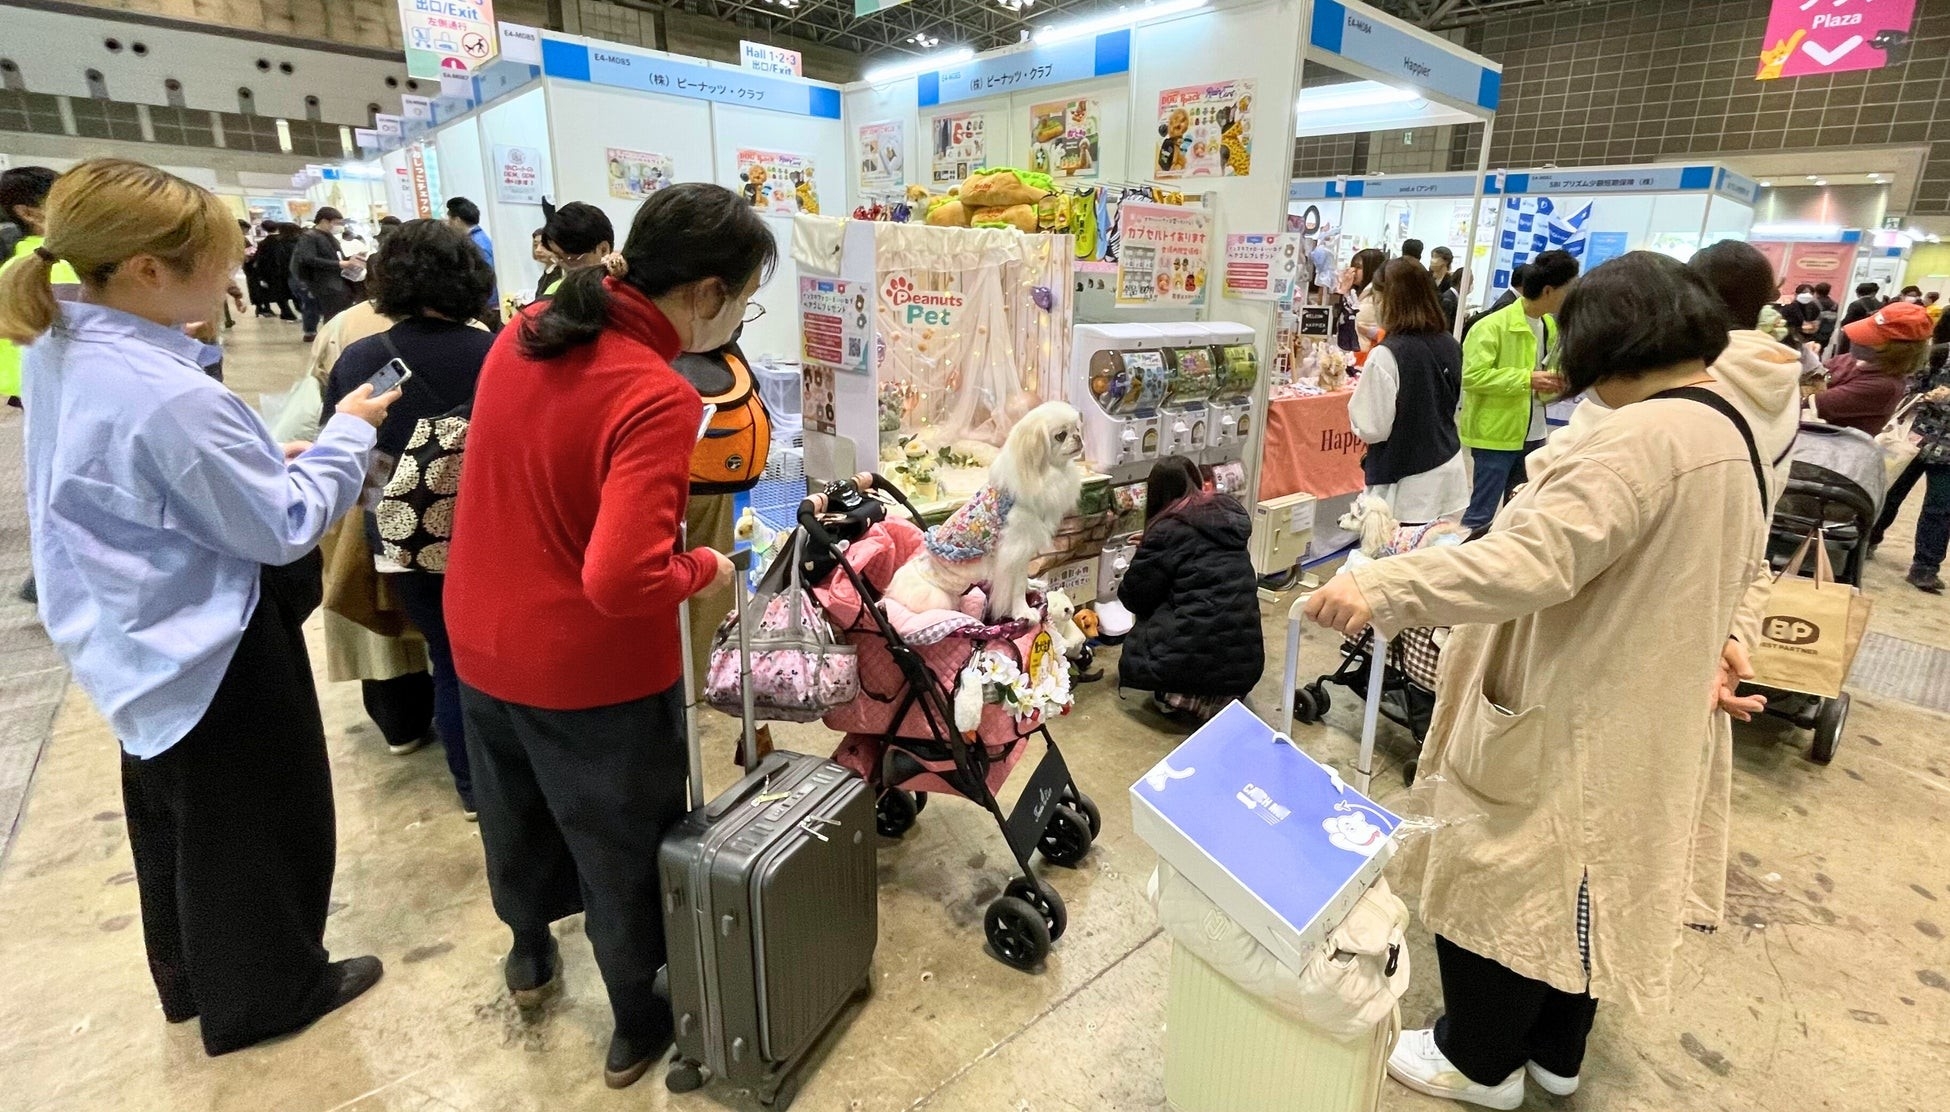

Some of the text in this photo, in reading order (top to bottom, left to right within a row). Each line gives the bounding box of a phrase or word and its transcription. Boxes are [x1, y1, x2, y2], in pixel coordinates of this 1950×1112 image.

[415, 0, 479, 20] 出口/Exit
[427, 17, 467, 31] 左側通行
[1811, 13, 1863, 30] Plaza
[594, 53, 631, 67] E4-M085
[746, 45, 766, 60] Hall
[752, 60, 792, 76] 出口/Exit
[1404, 56, 1432, 78] Happier
[892, 289, 964, 307] Peanuts
[906, 304, 951, 326] Pet
[1767, 618, 1813, 641] BP
[1778, 644, 1818, 655] PARTNER
